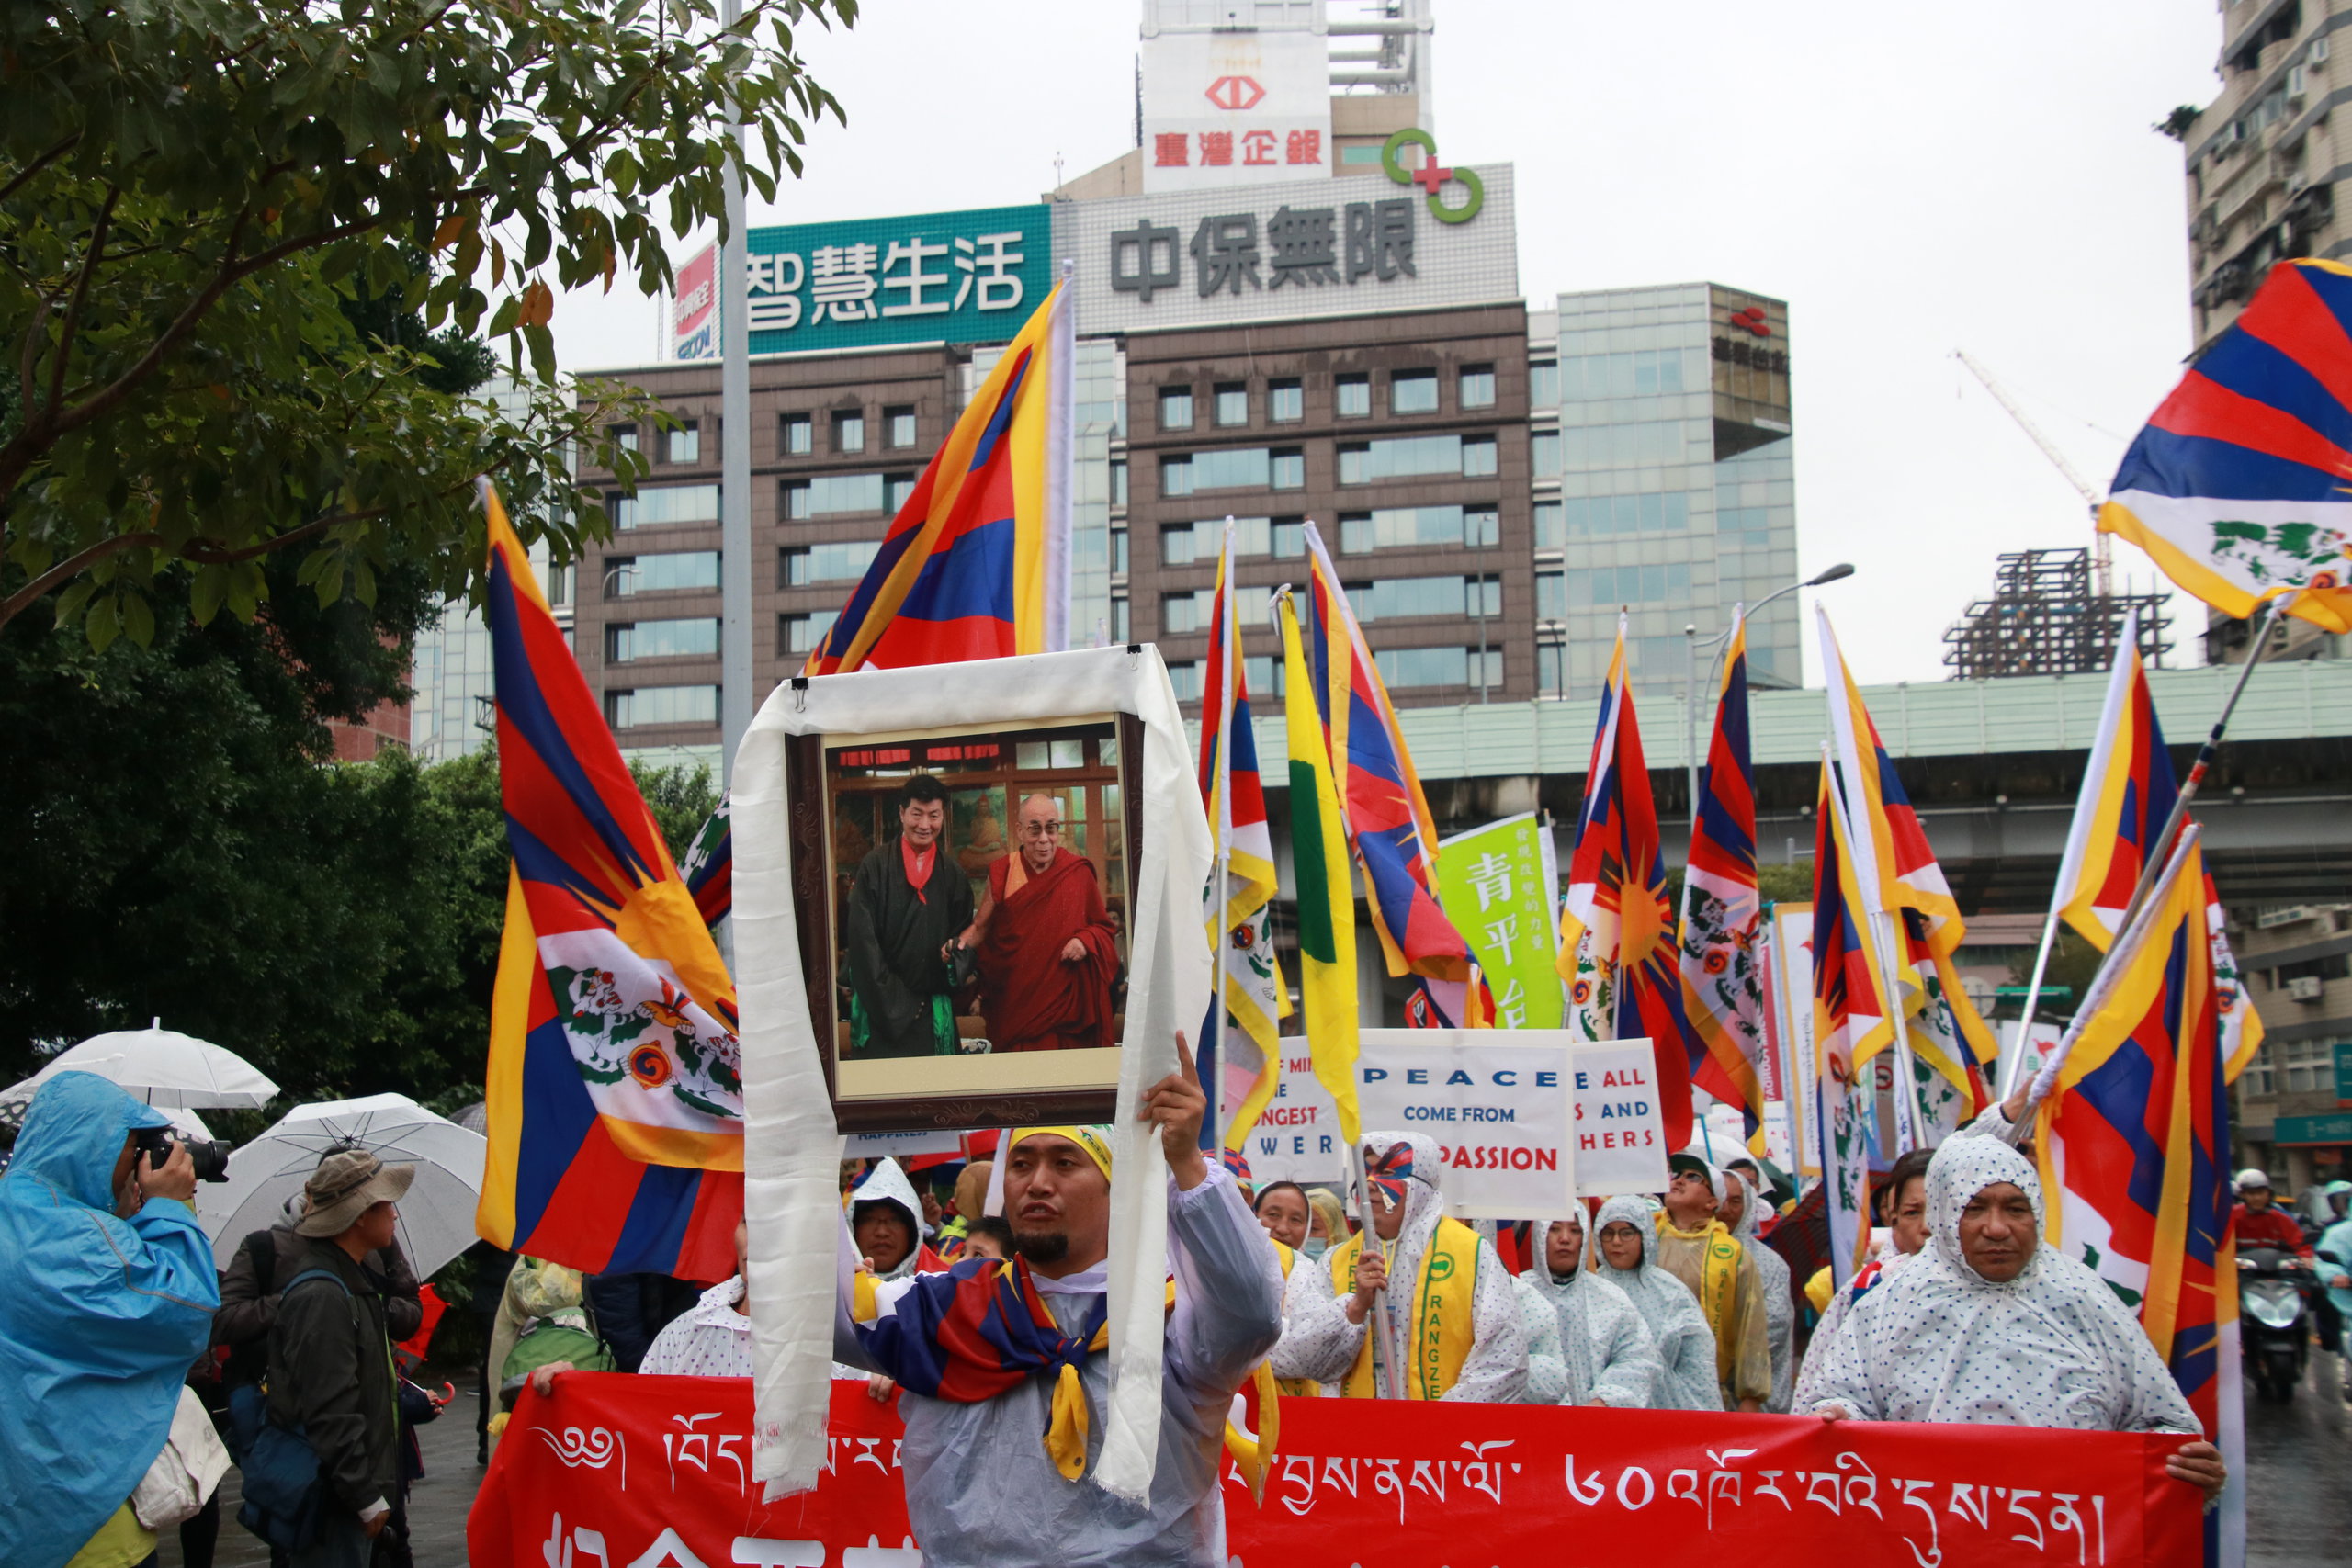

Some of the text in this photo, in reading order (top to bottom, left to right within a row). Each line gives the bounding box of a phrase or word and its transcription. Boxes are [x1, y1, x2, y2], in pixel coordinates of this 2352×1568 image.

[1154, 130, 1322, 167] 臺灣企銀
[1111, 197, 1417, 302] 中保無限
[747, 231, 1023, 332] 智慧生活
[1363, 1068, 1558, 1088] PEACE
[1603, 1069, 1645, 1088] ALL
[1404, 1106, 1515, 1122] COME FROM
[1600, 1101, 1649, 1119] AND
